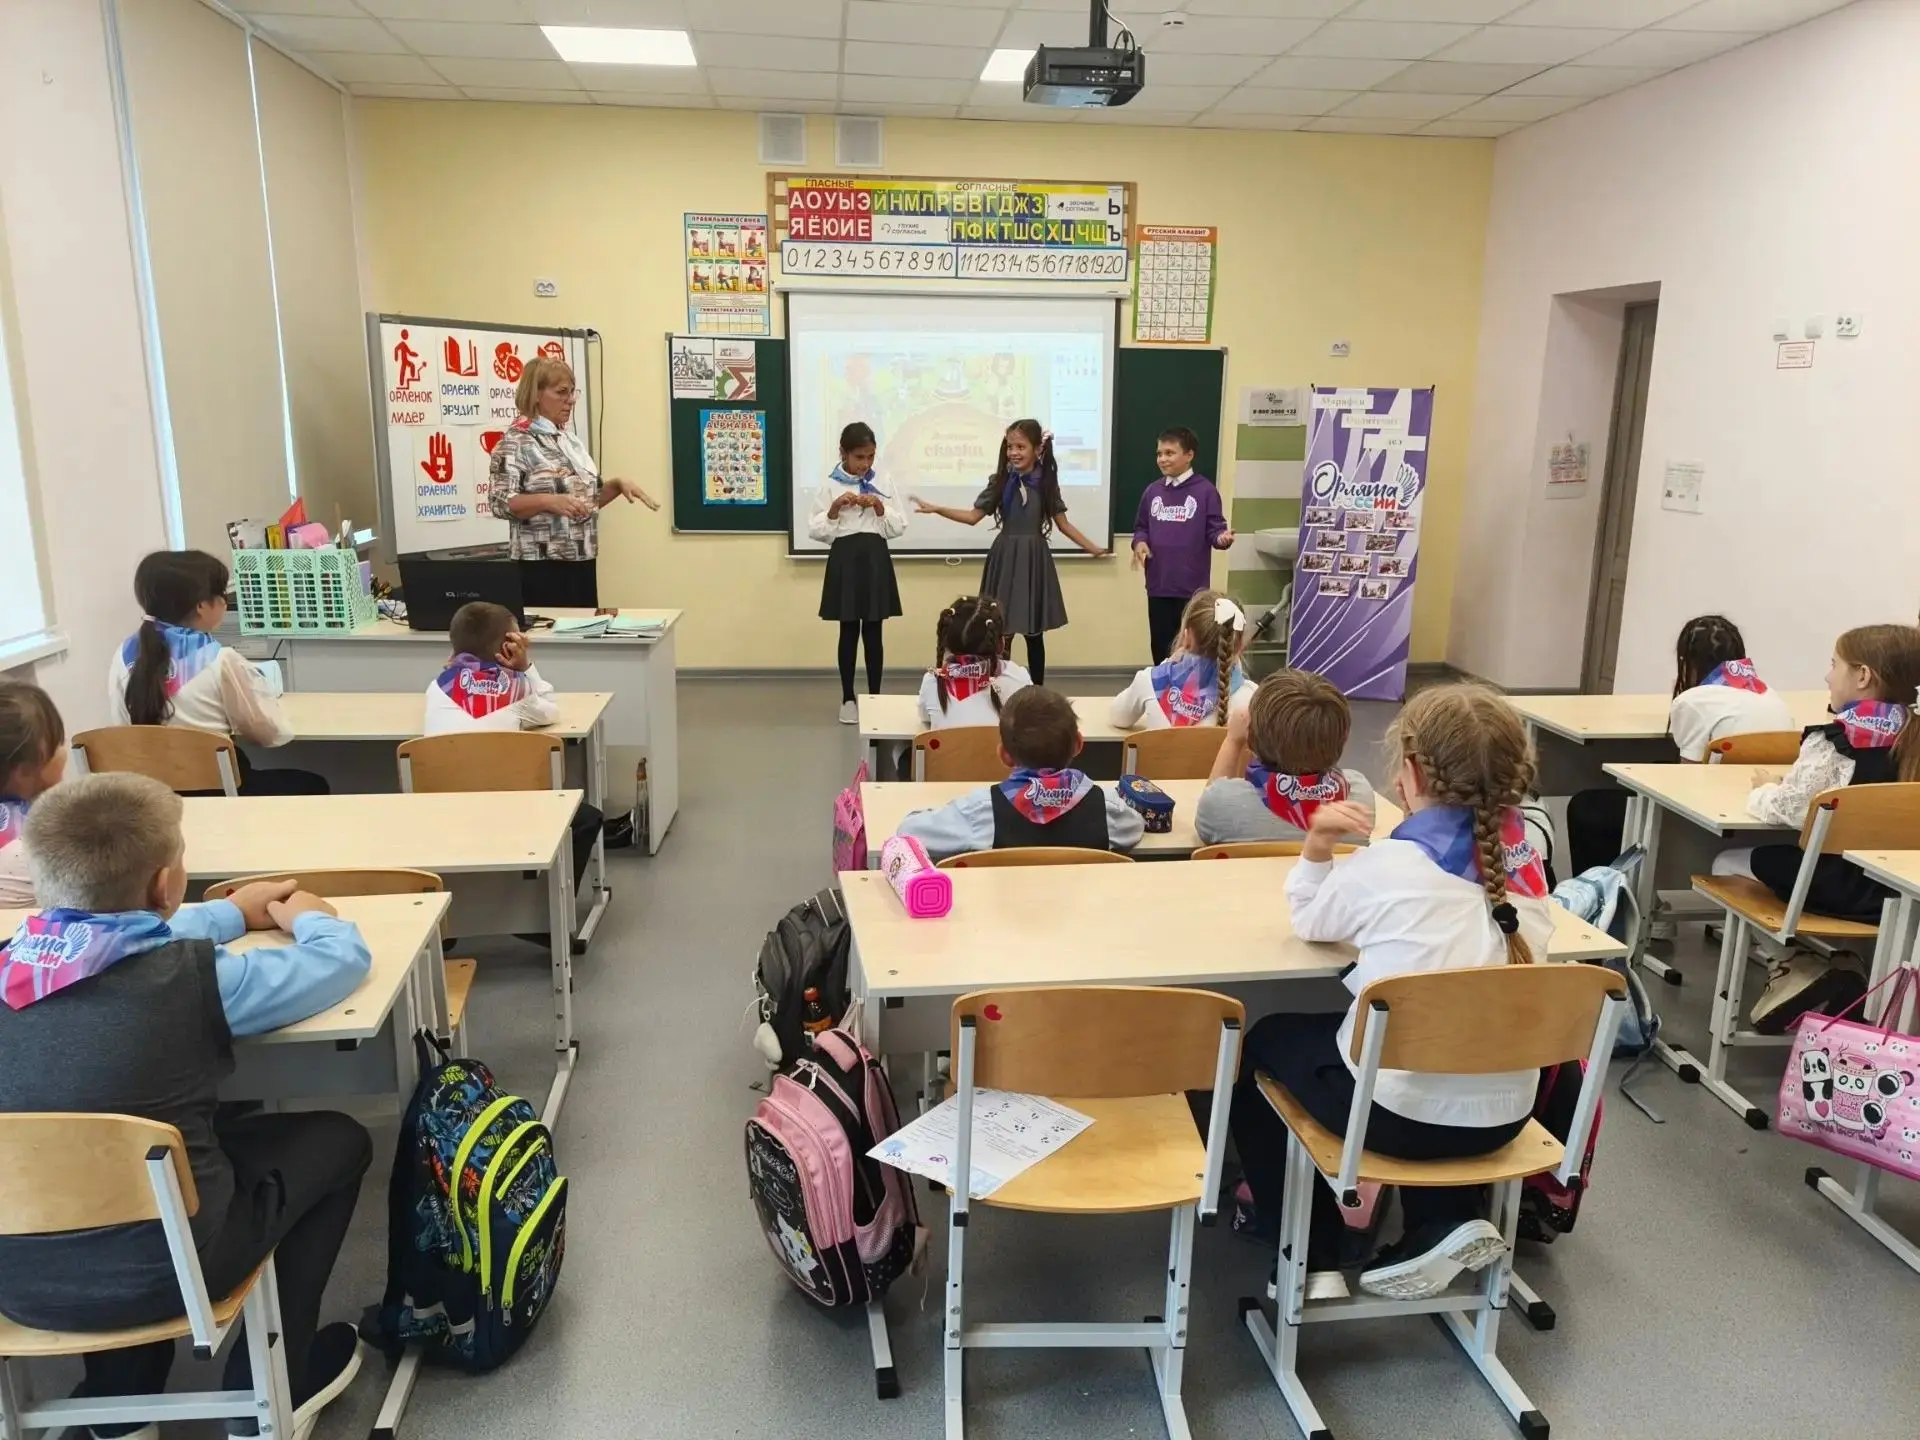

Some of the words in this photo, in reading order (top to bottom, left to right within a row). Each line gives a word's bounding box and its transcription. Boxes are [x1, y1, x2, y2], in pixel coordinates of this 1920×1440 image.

[805, 179, 854, 188] ГЛАСНЫЕ
[956, 183, 1017, 192] СОГЛАСНЫЕ
[442, 405, 480, 416] ЭРУДИТ
[1314, 462, 1398, 501] Орлята
